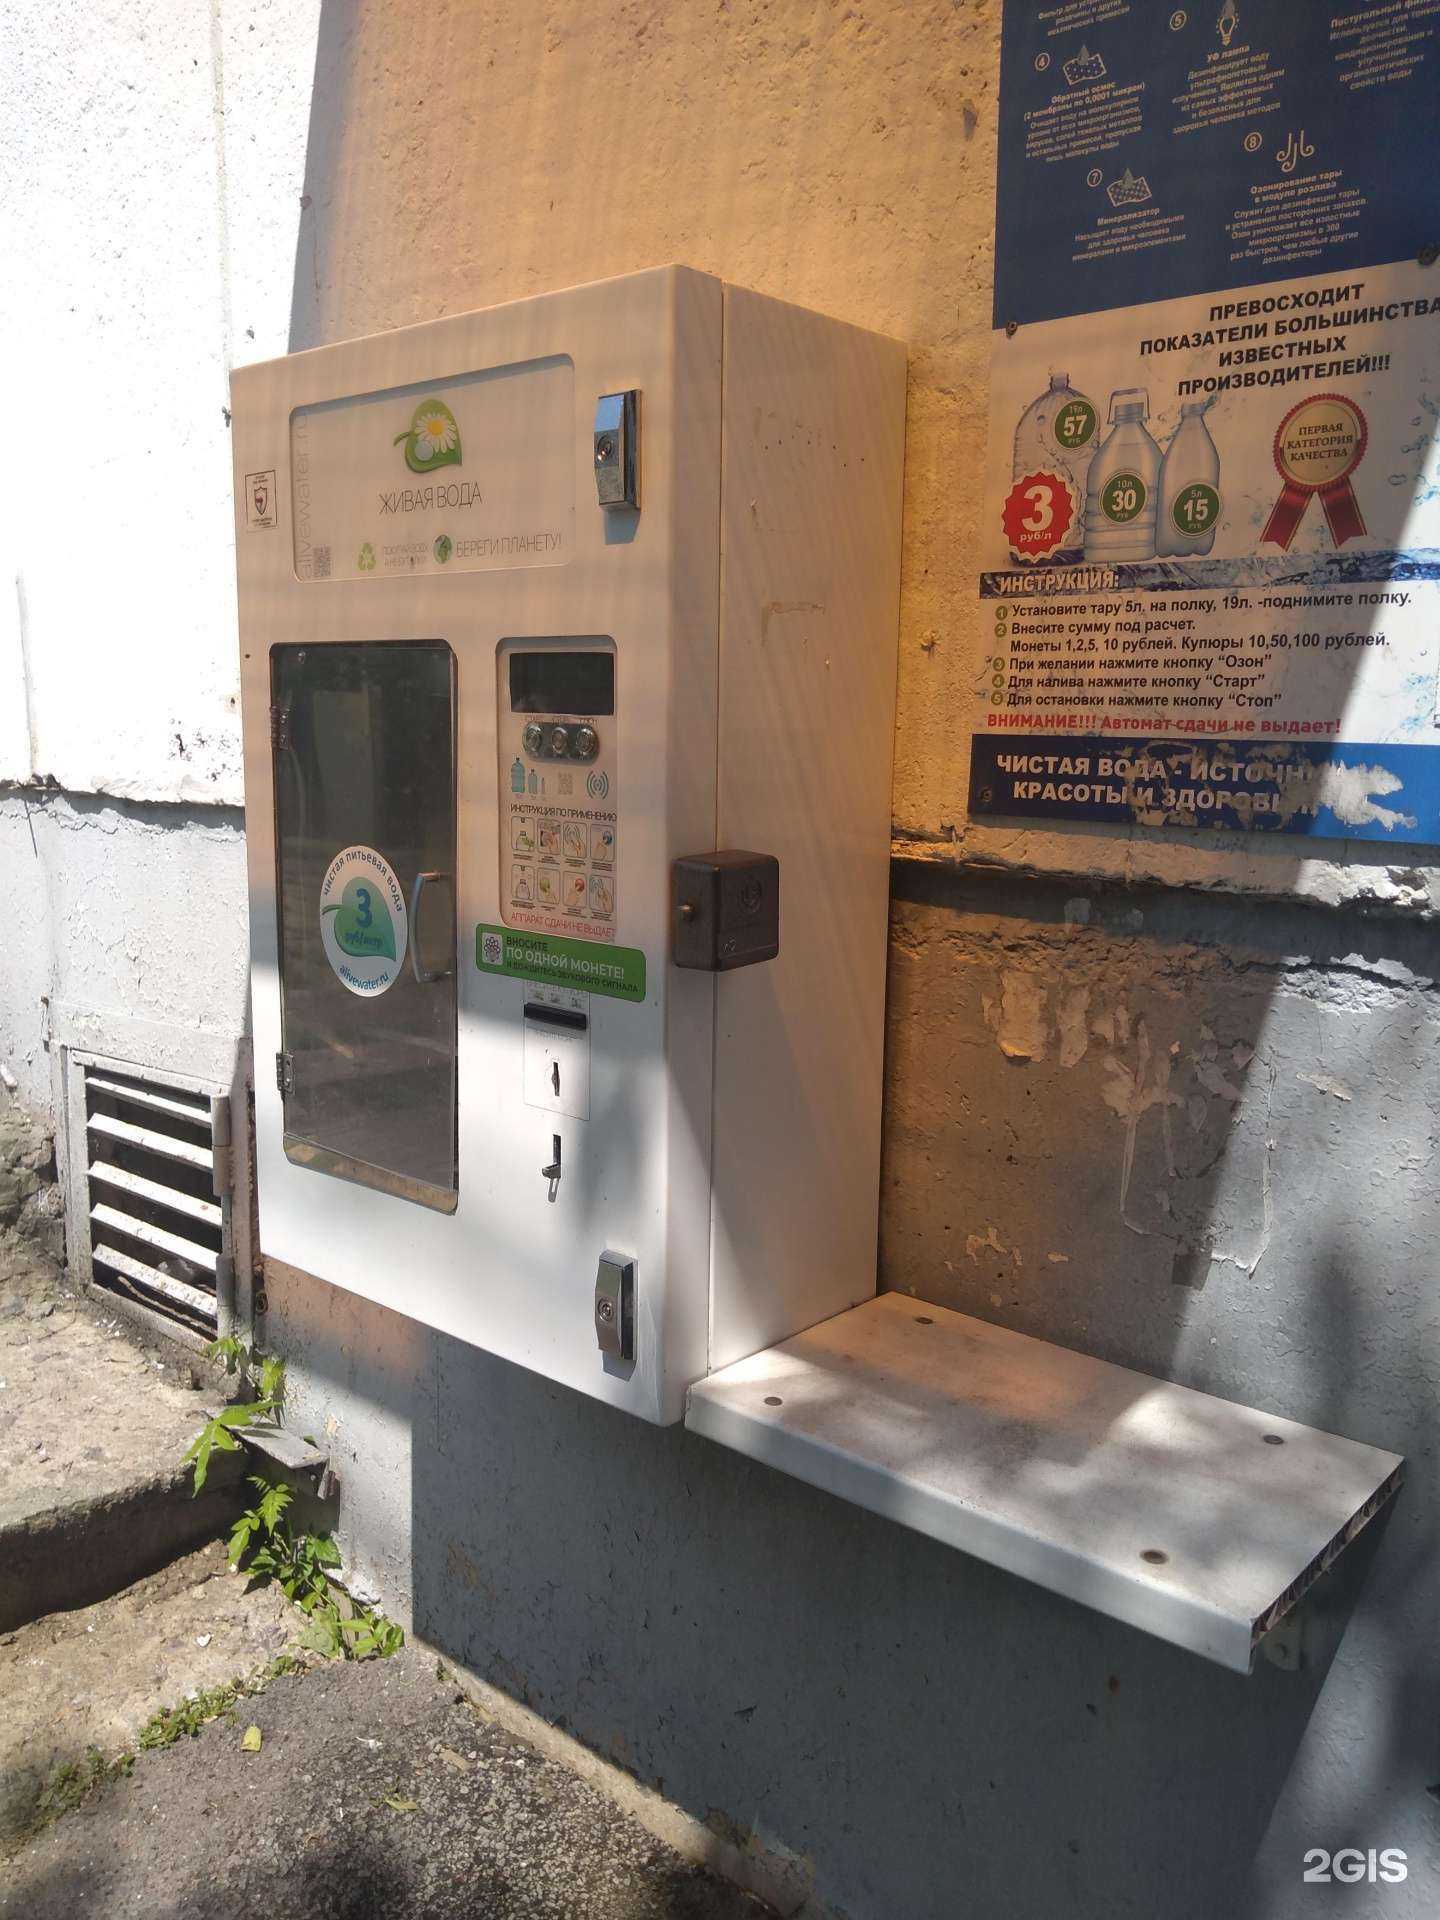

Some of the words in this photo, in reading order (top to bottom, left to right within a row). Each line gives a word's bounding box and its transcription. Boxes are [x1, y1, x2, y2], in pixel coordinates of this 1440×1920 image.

[1052, 89, 1090, 104] Обратный
[1250, 136, 1256, 148] 8
[1250, 176, 1317, 194] Озонирование
[1320, 170, 1343, 182] тары
[1262, 190, 1296, 202] модуле
[1298, 180, 1337, 196] розлива
[1097, 208, 1160, 226] Минерализатор
[1210, 283, 1366, 322] ПРЕВОСХОДИТ
[1140, 323, 1269, 356] ПОКАЗАТЕЛИ
[1274, 297, 1440, 336] БОЛЬШИНСТВА
[1218, 336, 1348, 368] ИЗВЕСТНЫХ
[1178, 353, 1391, 396] ПРОИЗВОДИТЕЛЕЙ!!!
[1064, 415, 1088, 437] 57
[1298, 422, 1344, 436] ПЕРВАЯ
[1287, 434, 1354, 451] КАТЕГОРИЯ
[1290, 448, 1348, 462] КАЧЕСТВА
[378, 487, 434, 515] ЖИВАЯ
[436, 482, 482, 509] ВОДА
[1021, 485, 1053, 532] 3
[1112, 488, 1136, 512] 30
[1184, 498, 1209, 521] 15
[456, 537, 499, 558] БЕРЕГИ
[1019, 530, 1052, 544] руб/л
[1000, 569, 1120, 594] ИНСТРУКЦИЯ:
[1012, 604, 1087, 616] Установите
[1090, 604, 1121, 616] тару
[1125, 600, 1146, 613] 5л.
[1150, 602, 1167, 612] на
[1171, 600, 1216, 613] полку,
[1222, 596, 1253, 609] 19л.
[1257, 594, 1354, 608] -поднимите
[1358, 592, 1412, 607] полку.
[1012, 622, 1065, 634] Внесите
[1068, 622, 1111, 634] сумму
[1115, 622, 1141, 633] под
[1144, 619, 1196, 634] расчет.
[1010, 639, 1062, 652] Монеты
[1104, 638, 1119, 650] 10
[1122, 636, 1177, 652] рублей.
[1182, 635, 1244, 650] Купюры
[1248, 632, 1320, 650] 10,50,100
[1324, 632, 1390, 650] рублей.
[1010, 658, 1034, 670] При
[1037, 658, 1095, 669] желании
[1099, 658, 1159, 669] нажмите
[1163, 656, 1214, 670] кнопку
[1218, 654, 1272, 668] “Озон”
[1008, 676, 1033, 689] Для
[1036, 676, 1084, 688] налива
[1087, 676, 1148, 688] нажмите
[1151, 676, 1200, 690] кнопку
[1206, 674, 1265, 690] “Старт”
[1007, 694, 1032, 707] Для
[1035, 695, 1104, 706] остановки
[1108, 695, 1169, 706] нажмите
[1173, 696, 1224, 709] кнопку
[1228, 694, 1282, 708] “Стоп”
[987, 714, 1096, 730] ВНИМАНИЕ!!!
[1101, 716, 1170, 730] Автомат
[1176, 719, 1228, 732] сдачи
[1232, 719, 1256, 732] не
[1261, 718, 1342, 734] выдает!
[997, 754, 1090, 776] ЧИСТАЯ
[1098, 758, 1166, 782] ВОДА
[1013, 781, 1128, 804] КРАСОТЫ
[1138, 788, 1154, 806] И
[556, 808, 567, 817] ПО
[324, 857, 345, 896] чистая
[346, 850, 387, 876] питьевая
[386, 877, 402, 912] вода
[356, 888, 373, 928] 3
[506, 936, 548, 951] ВНОСИТЕ
[506, 946, 522, 960] ПО
[526, 950, 568, 968] ОДНОЙ
[570, 958, 625, 980] МОНЕТЕ!
[340, 964, 390, 990] alivewater.ru
[601, 978, 639, 994] СИГНАЛА
